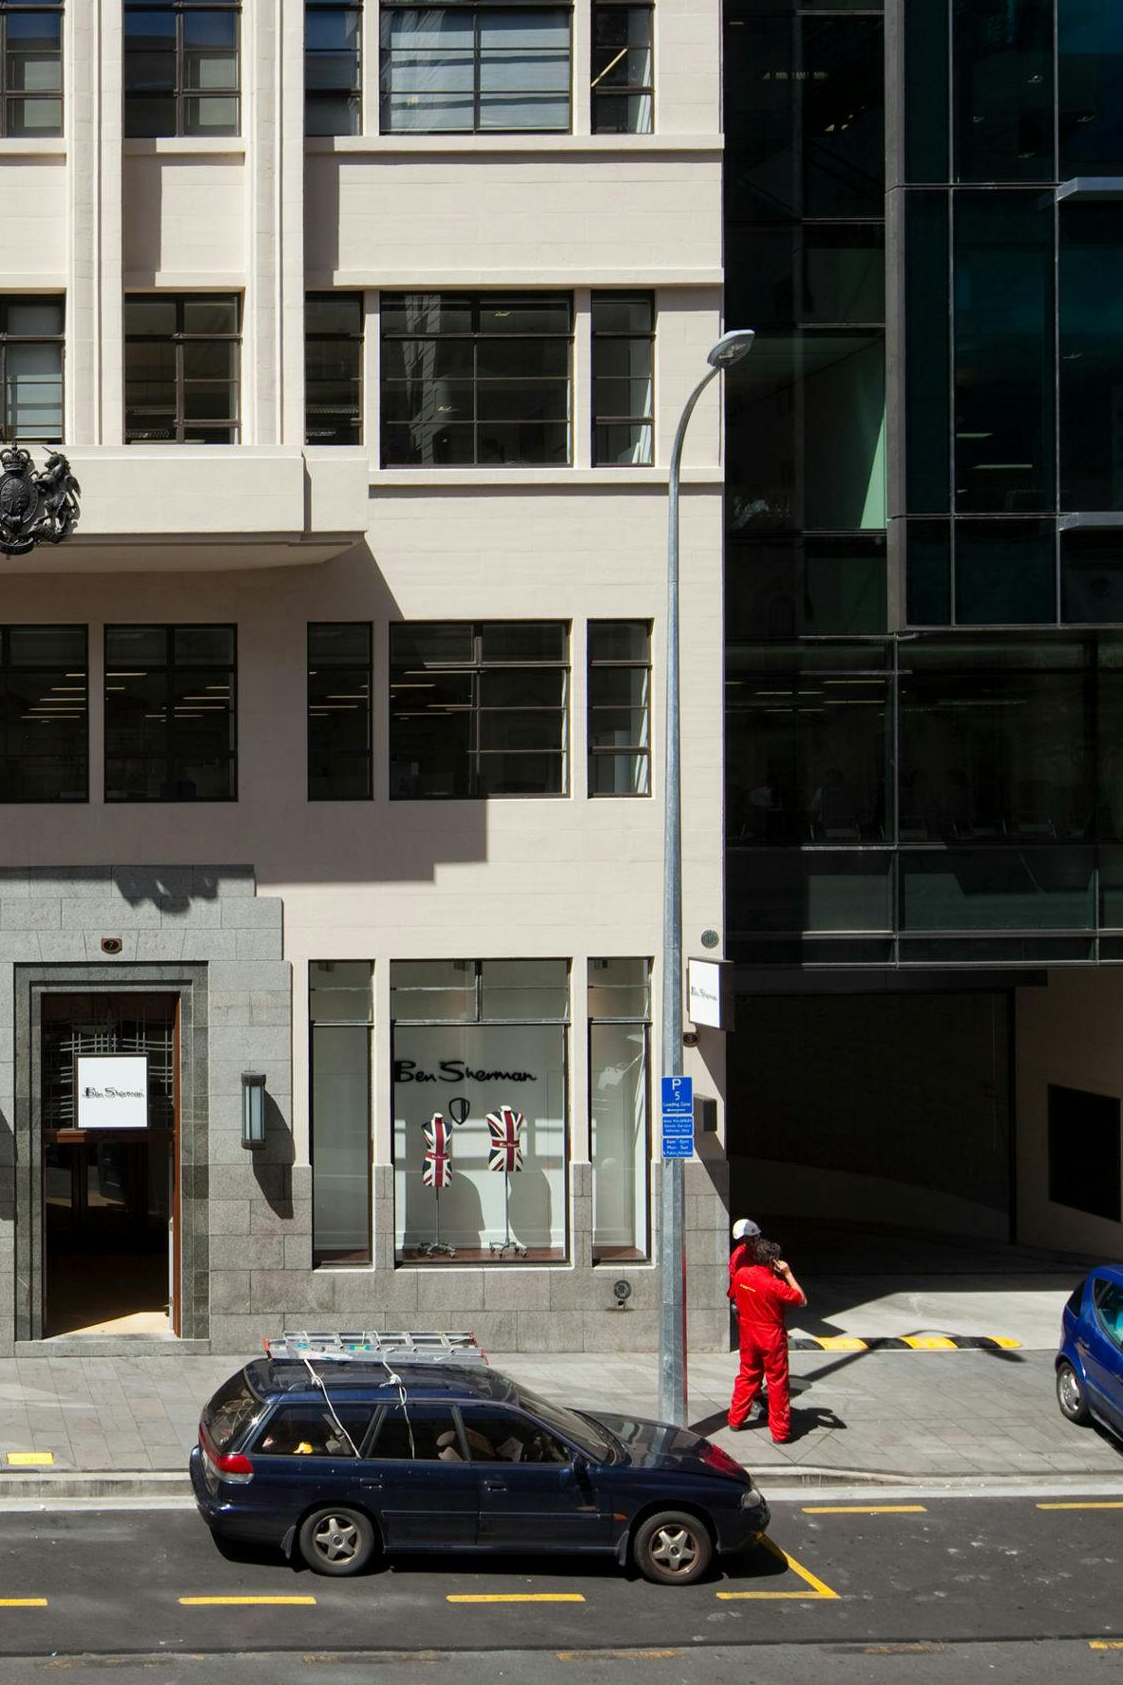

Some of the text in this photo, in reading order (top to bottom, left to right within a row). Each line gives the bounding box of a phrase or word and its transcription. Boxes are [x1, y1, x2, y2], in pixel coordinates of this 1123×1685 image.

[394, 1060, 537, 1083] Ben Sherman
[672, 1078, 681, 1090] P
[674, 1091, 680, 1101] 5
